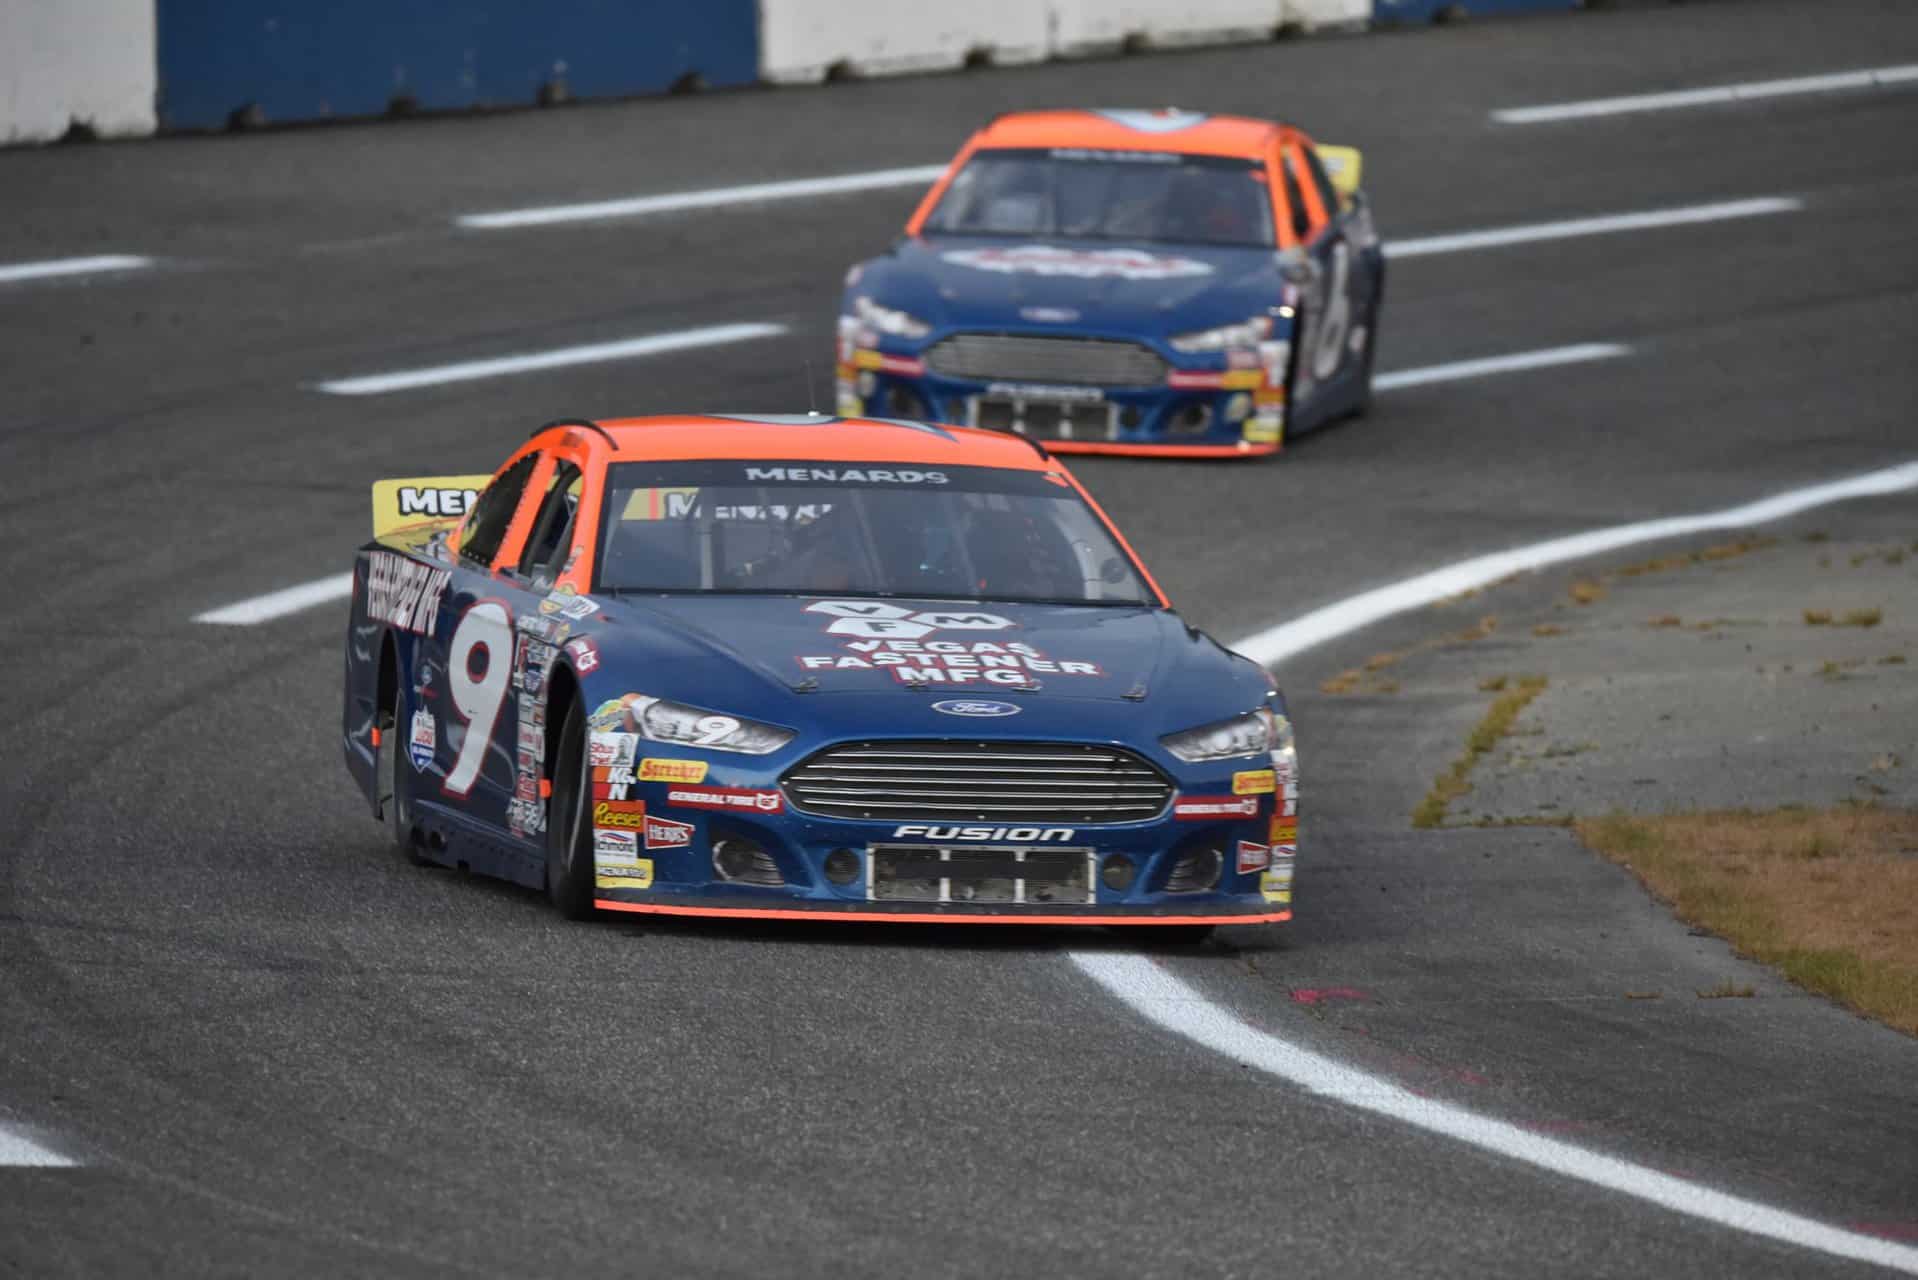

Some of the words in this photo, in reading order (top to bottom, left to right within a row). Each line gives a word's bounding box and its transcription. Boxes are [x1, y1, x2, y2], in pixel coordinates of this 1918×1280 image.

[745, 467, 949, 484] MENARDS
[846, 639, 1041, 657] VEGAS
[801, 652, 1099, 675] FASTENER
[896, 667, 1026, 684] MFG
[444, 601, 514, 794] 9
[693, 715, 741, 745] 9
[893, 825, 1075, 842] FUSION
